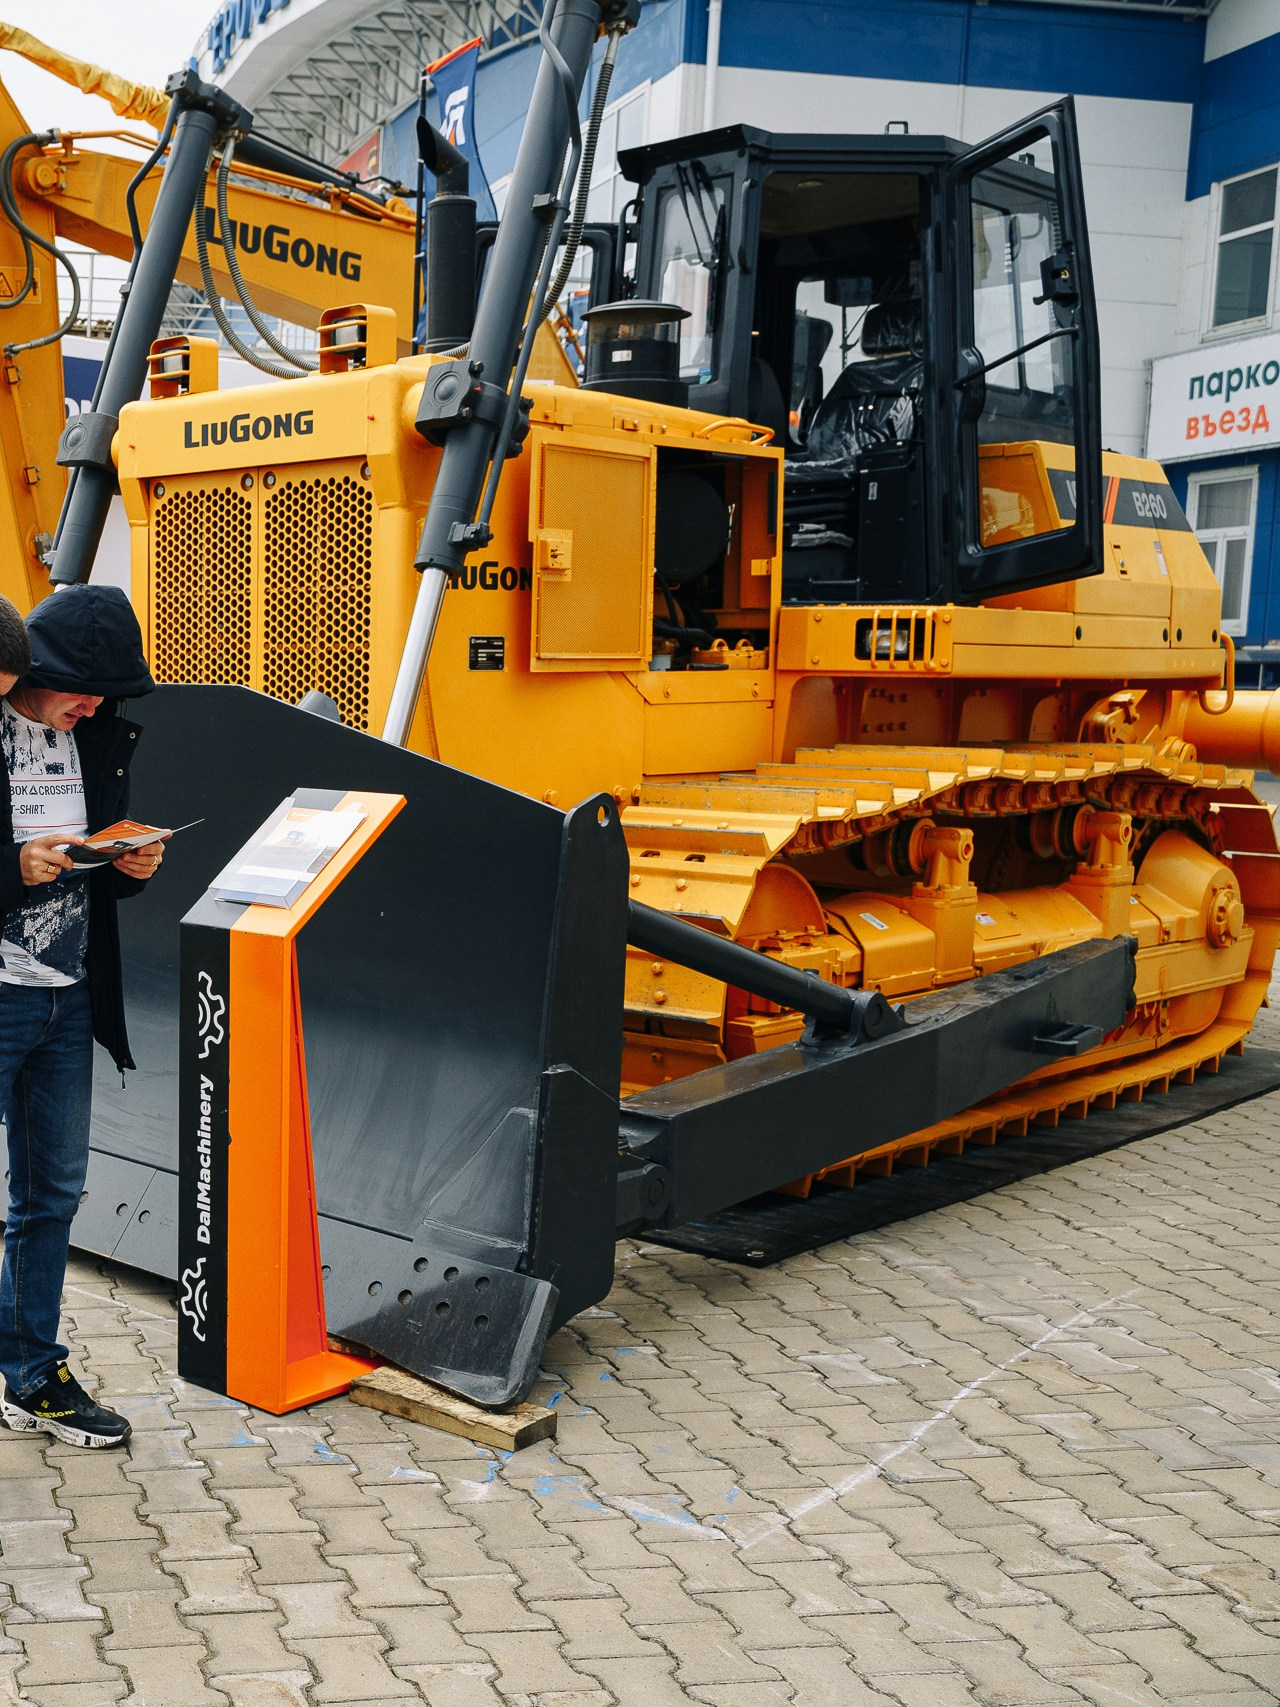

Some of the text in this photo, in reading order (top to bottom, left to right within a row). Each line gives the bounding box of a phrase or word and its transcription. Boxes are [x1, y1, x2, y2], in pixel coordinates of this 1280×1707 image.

[1189, 360, 1280, 403] парко
[1185, 404, 1270, 440] въезд
[1132, 491, 1168, 519] B260
[197, 1074, 214, 1245] DalMachinery
